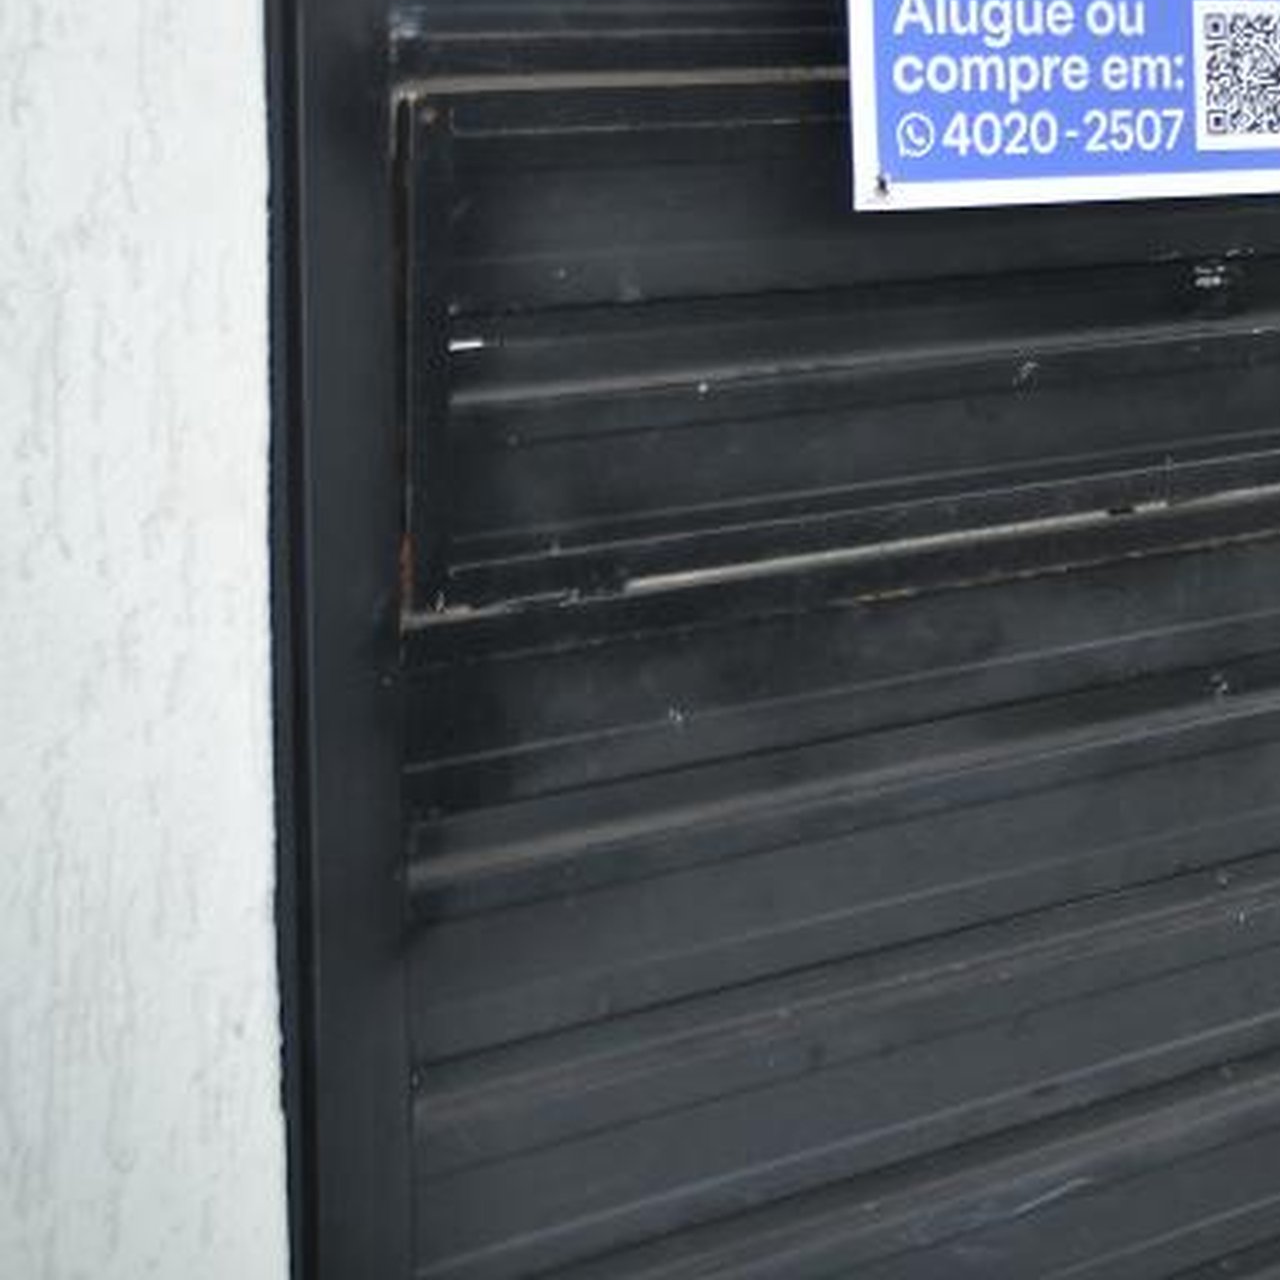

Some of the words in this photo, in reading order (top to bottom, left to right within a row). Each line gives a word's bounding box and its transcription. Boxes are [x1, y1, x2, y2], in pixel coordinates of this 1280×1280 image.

[1085, 0, 1145, 36] ou
[892, 54, 1090, 105] compre
[1101, 53, 1185, 92] em:
